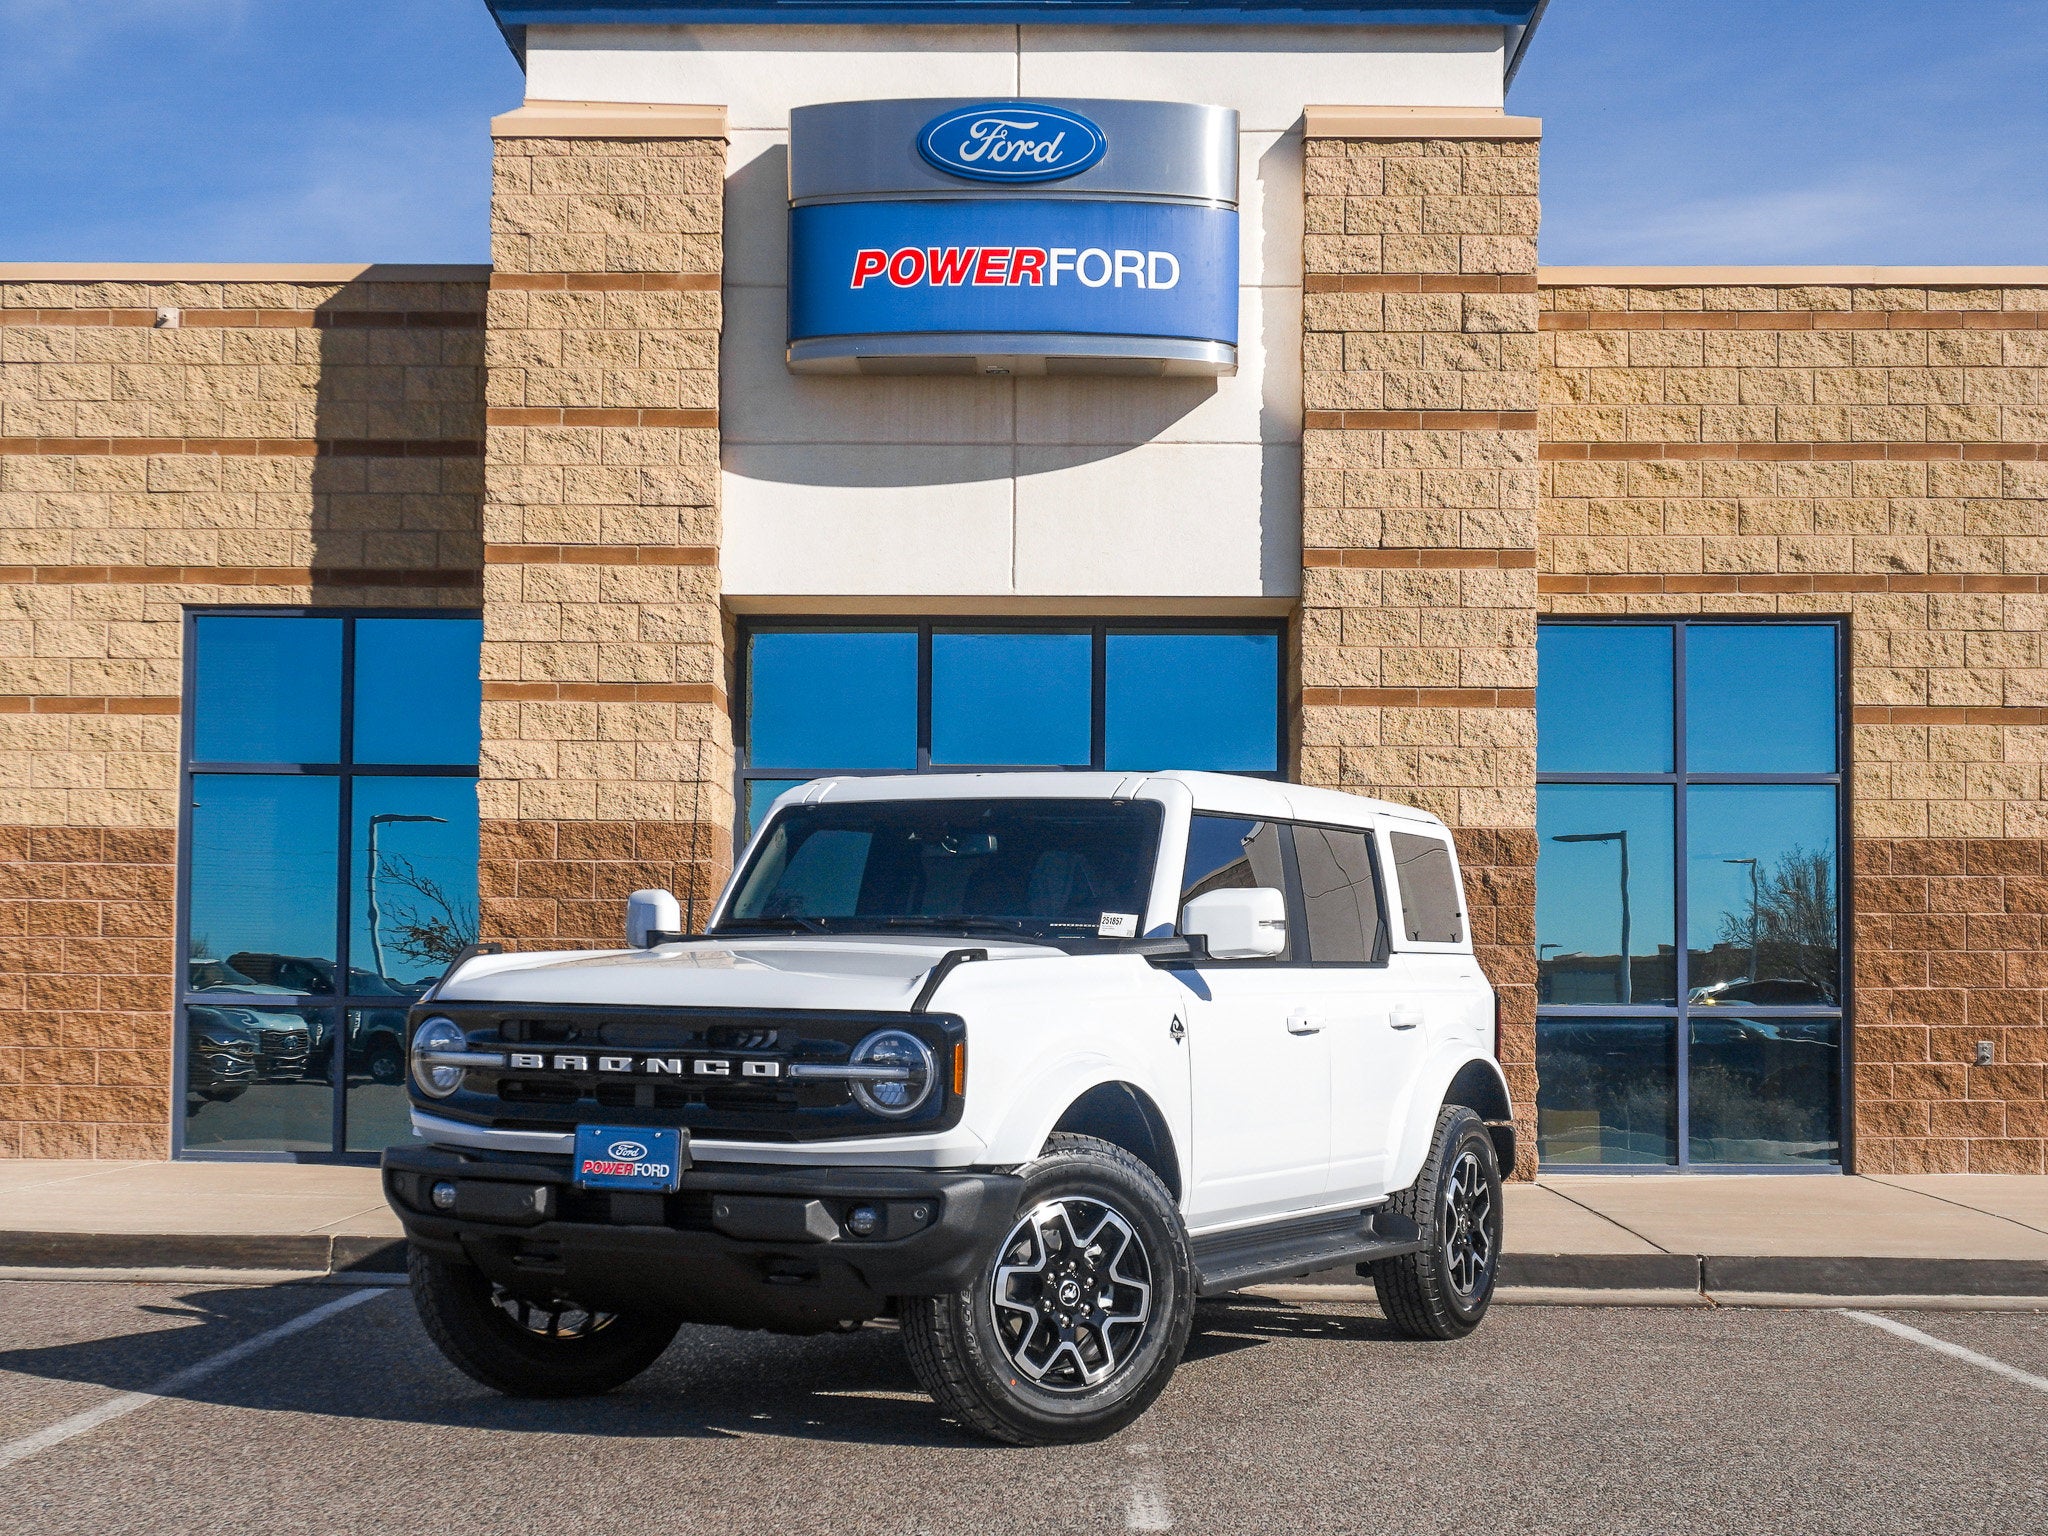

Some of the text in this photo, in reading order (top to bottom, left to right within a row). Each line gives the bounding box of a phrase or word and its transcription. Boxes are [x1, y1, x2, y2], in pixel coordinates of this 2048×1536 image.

[959, 118, 1066, 163] Ford
[1101, 916, 1123, 926] 251857
[511, 1053, 780, 1077] BRONCO
[615, 1144, 640, 1157] Ford
